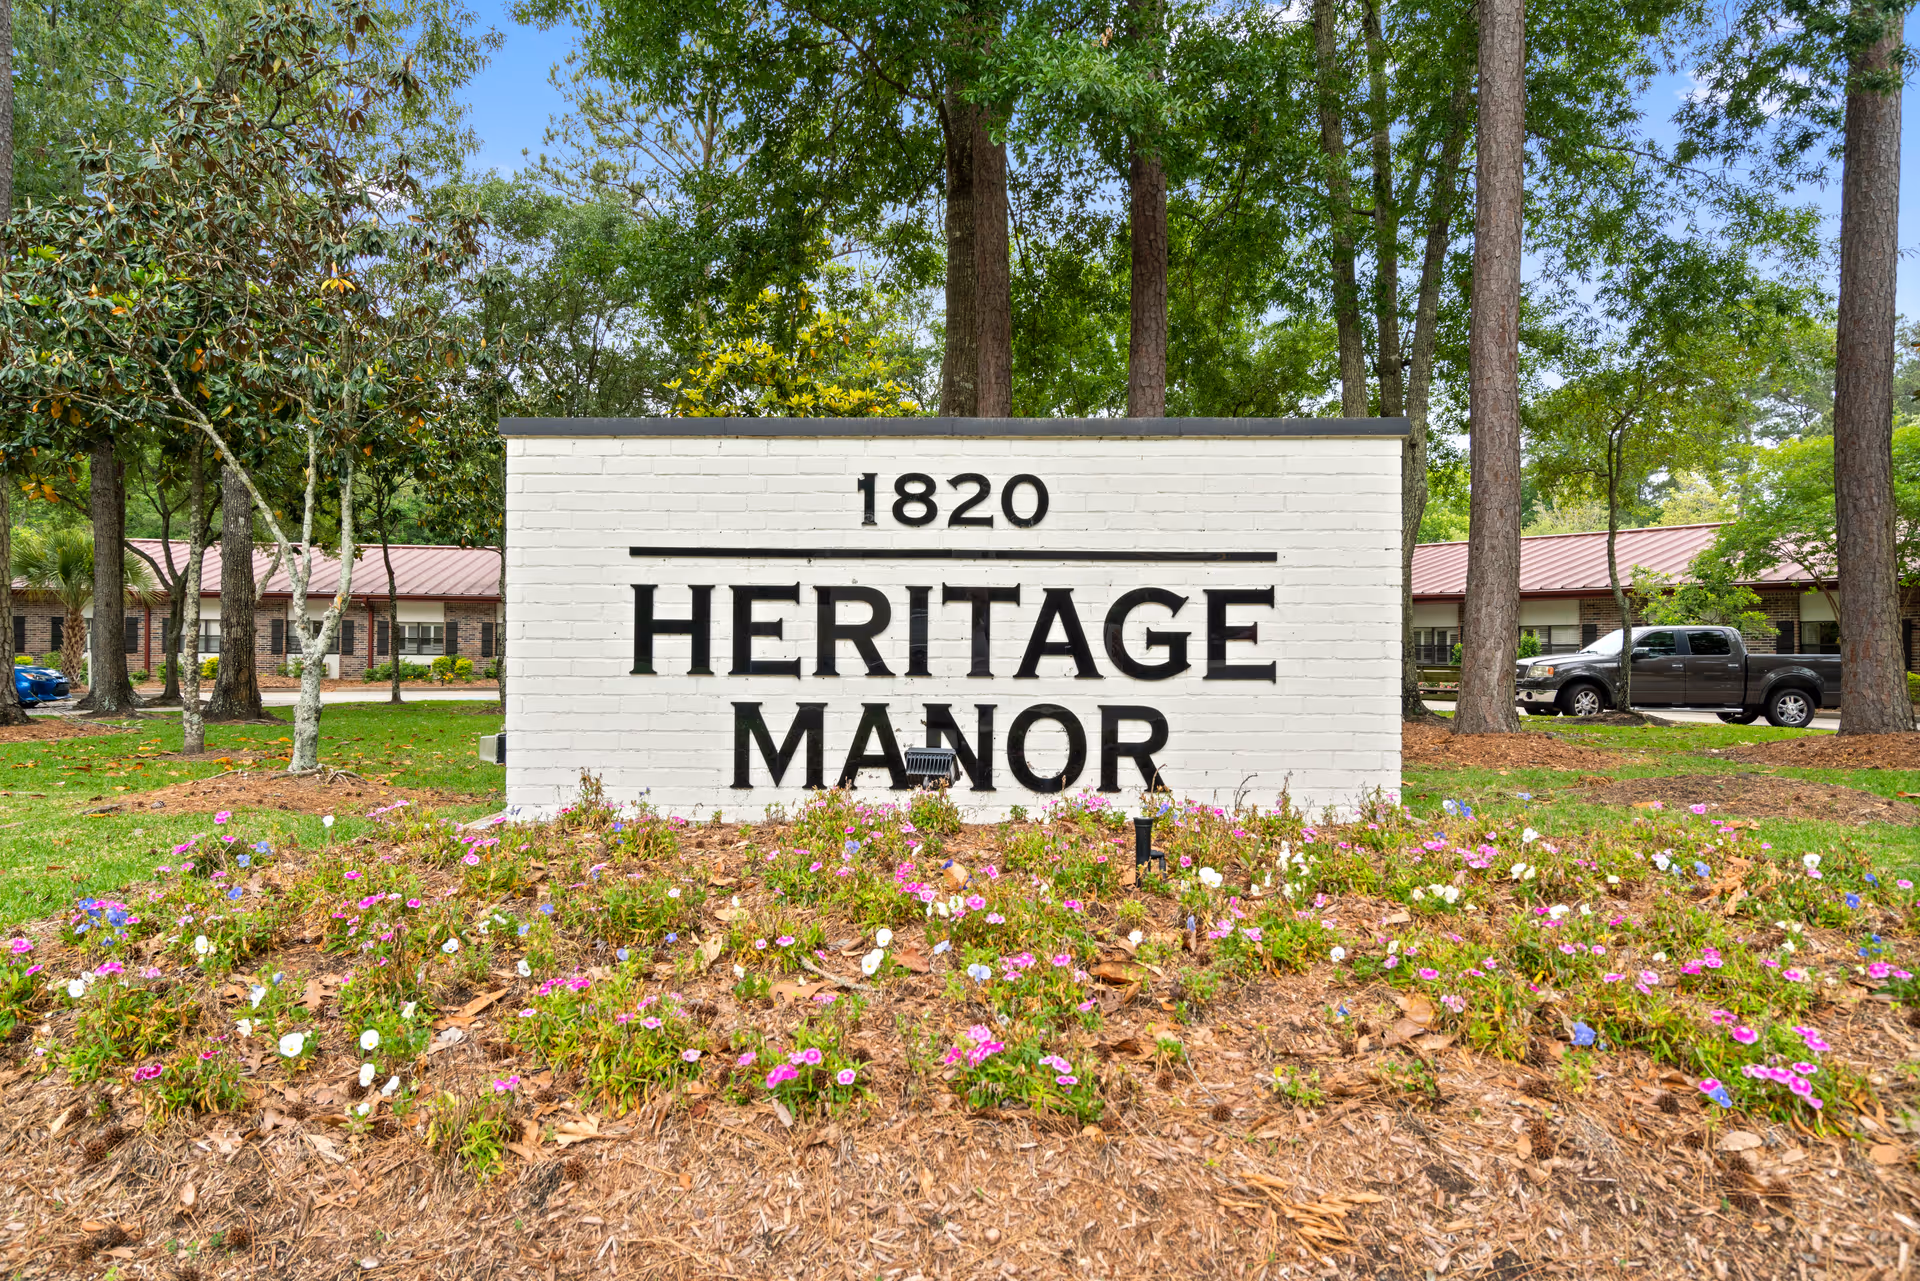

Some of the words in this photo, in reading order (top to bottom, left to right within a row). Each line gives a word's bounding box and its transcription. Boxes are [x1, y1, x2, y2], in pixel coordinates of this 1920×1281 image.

[857, 472, 1050, 529] 1820
[629, 582, 1277, 683] HERITAGE
[730, 701, 1170, 793] MANOR
